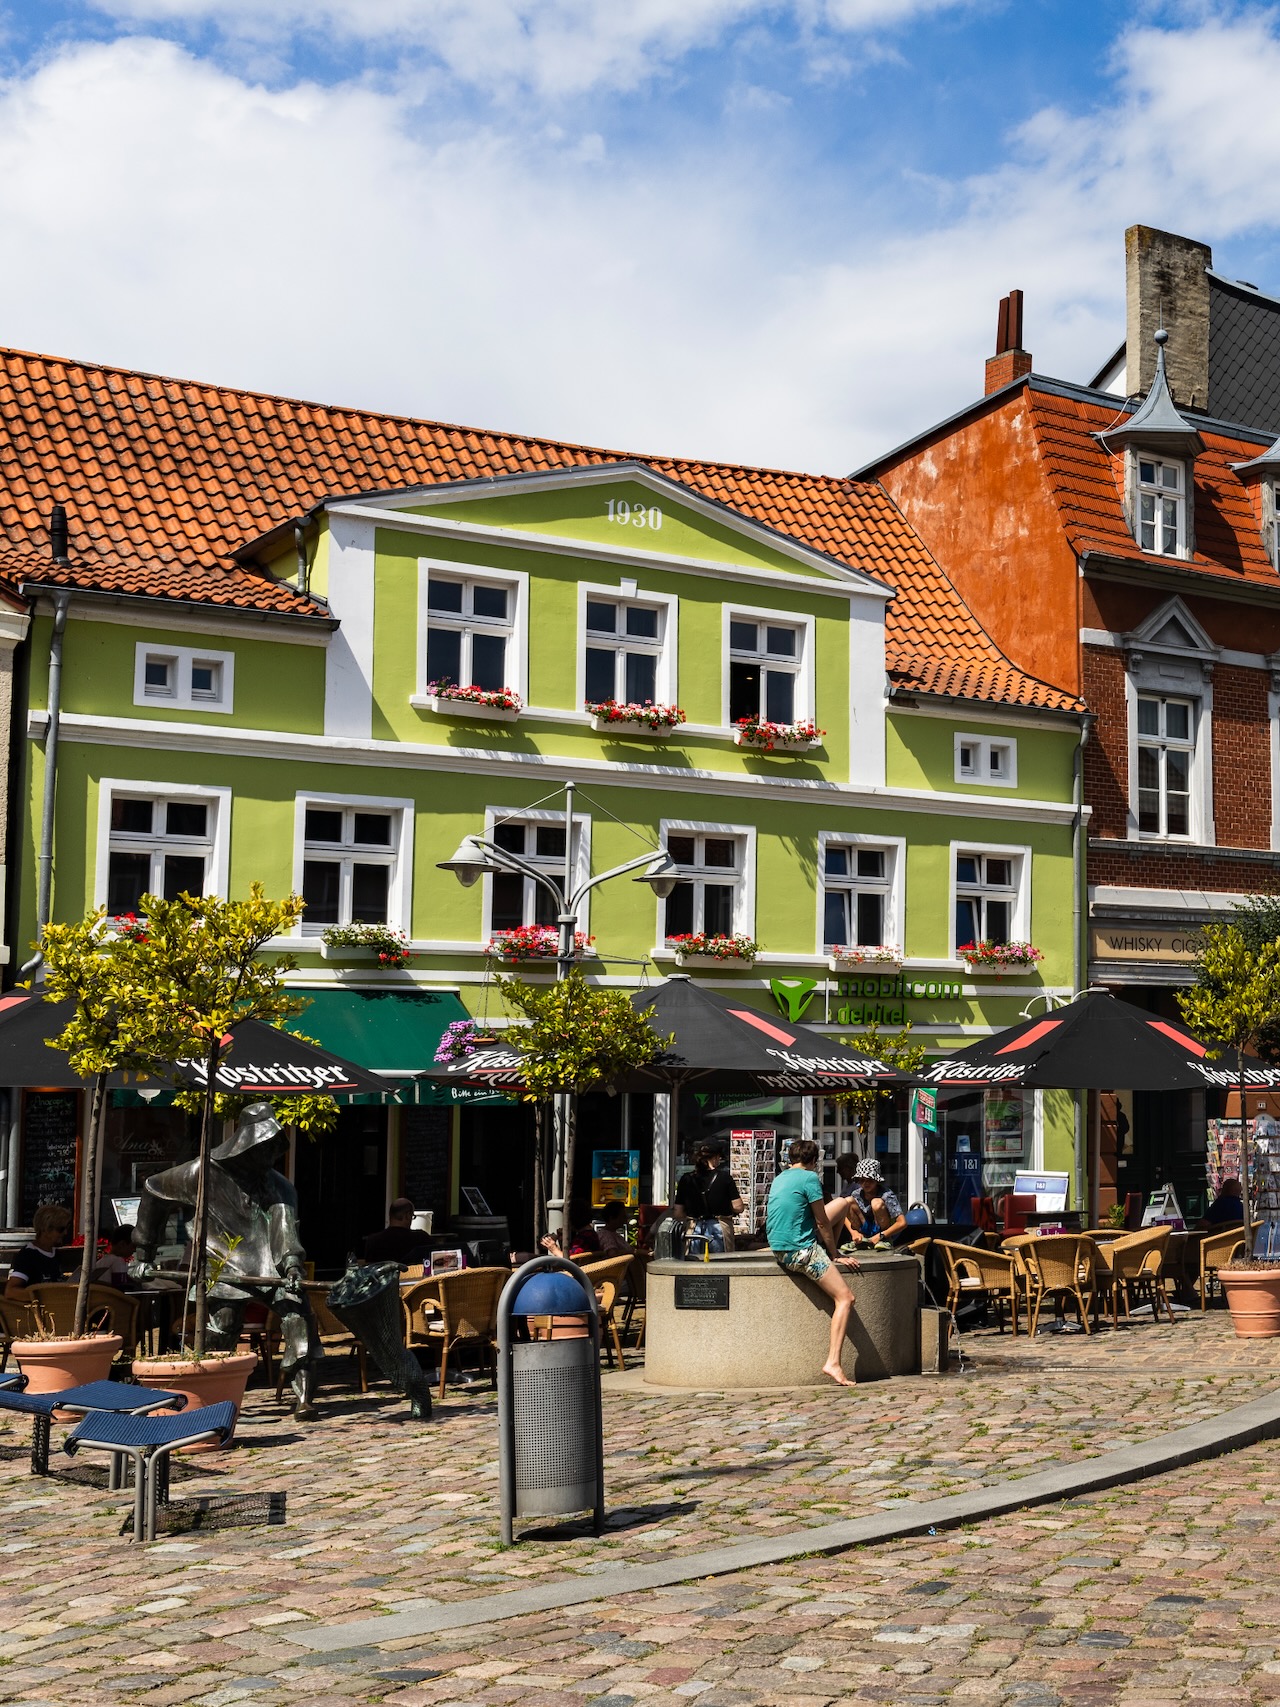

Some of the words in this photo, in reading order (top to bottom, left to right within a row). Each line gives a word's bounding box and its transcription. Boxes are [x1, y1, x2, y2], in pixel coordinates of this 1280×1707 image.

[604, 498, 663, 531] 1930
[1109, 936, 1162, 952] WHISKY
[838, 975, 963, 999] mobilcom
[838, 1002, 907, 1025] debitel
[766, 1048, 892, 1077] Köstritzer
[964, 1158, 978, 1170] 1&1
